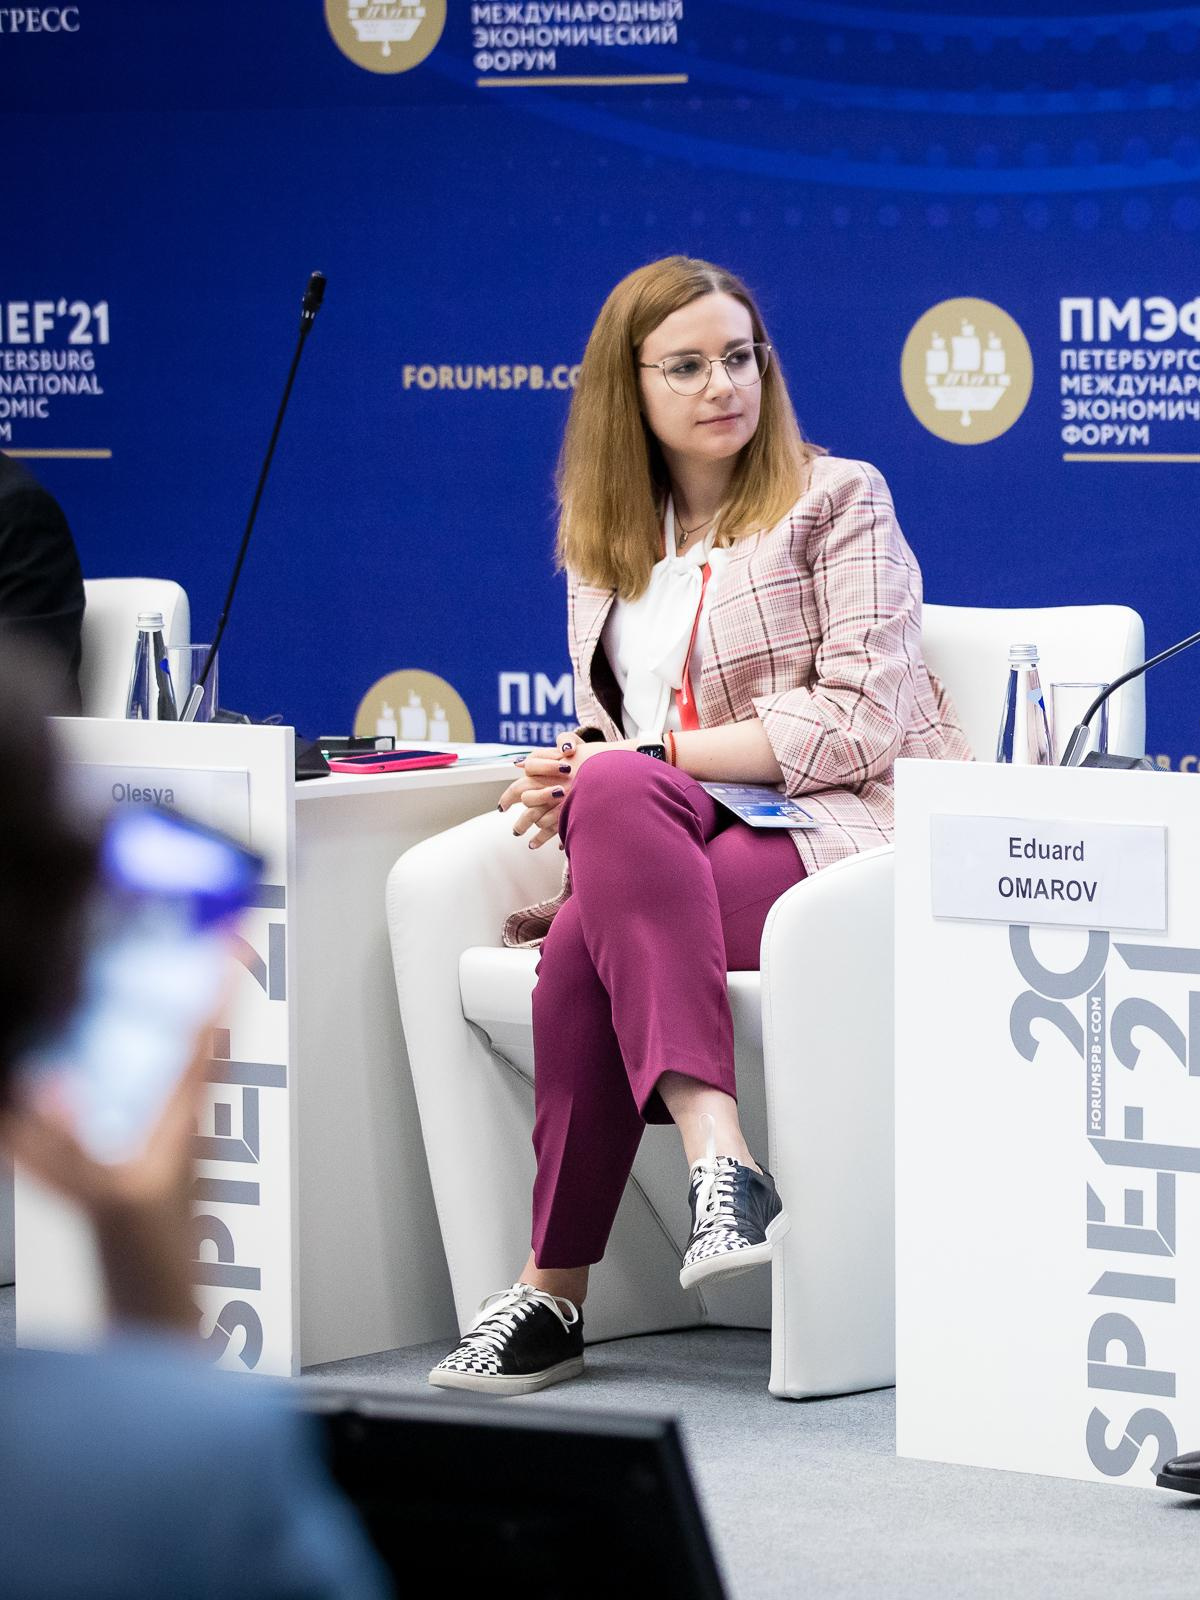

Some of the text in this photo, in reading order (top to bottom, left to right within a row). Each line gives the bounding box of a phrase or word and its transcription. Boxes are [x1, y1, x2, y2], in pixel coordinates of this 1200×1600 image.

[471, 0, 684, 25] МЕЖДУНАРОДНЫЙ
[472, 20, 679, 48] ЭКОНОМИЧЕСКИЙ
[473, 49, 557, 72] ФОРУМ
[0, 297, 110, 345] EF'21
[1061, 424, 1150, 446] ФОРУМ
[111, 783, 174, 807] Olesya
[1009, 836, 1084, 862] Eduard
[998, 876, 1098, 902] OMAROV
